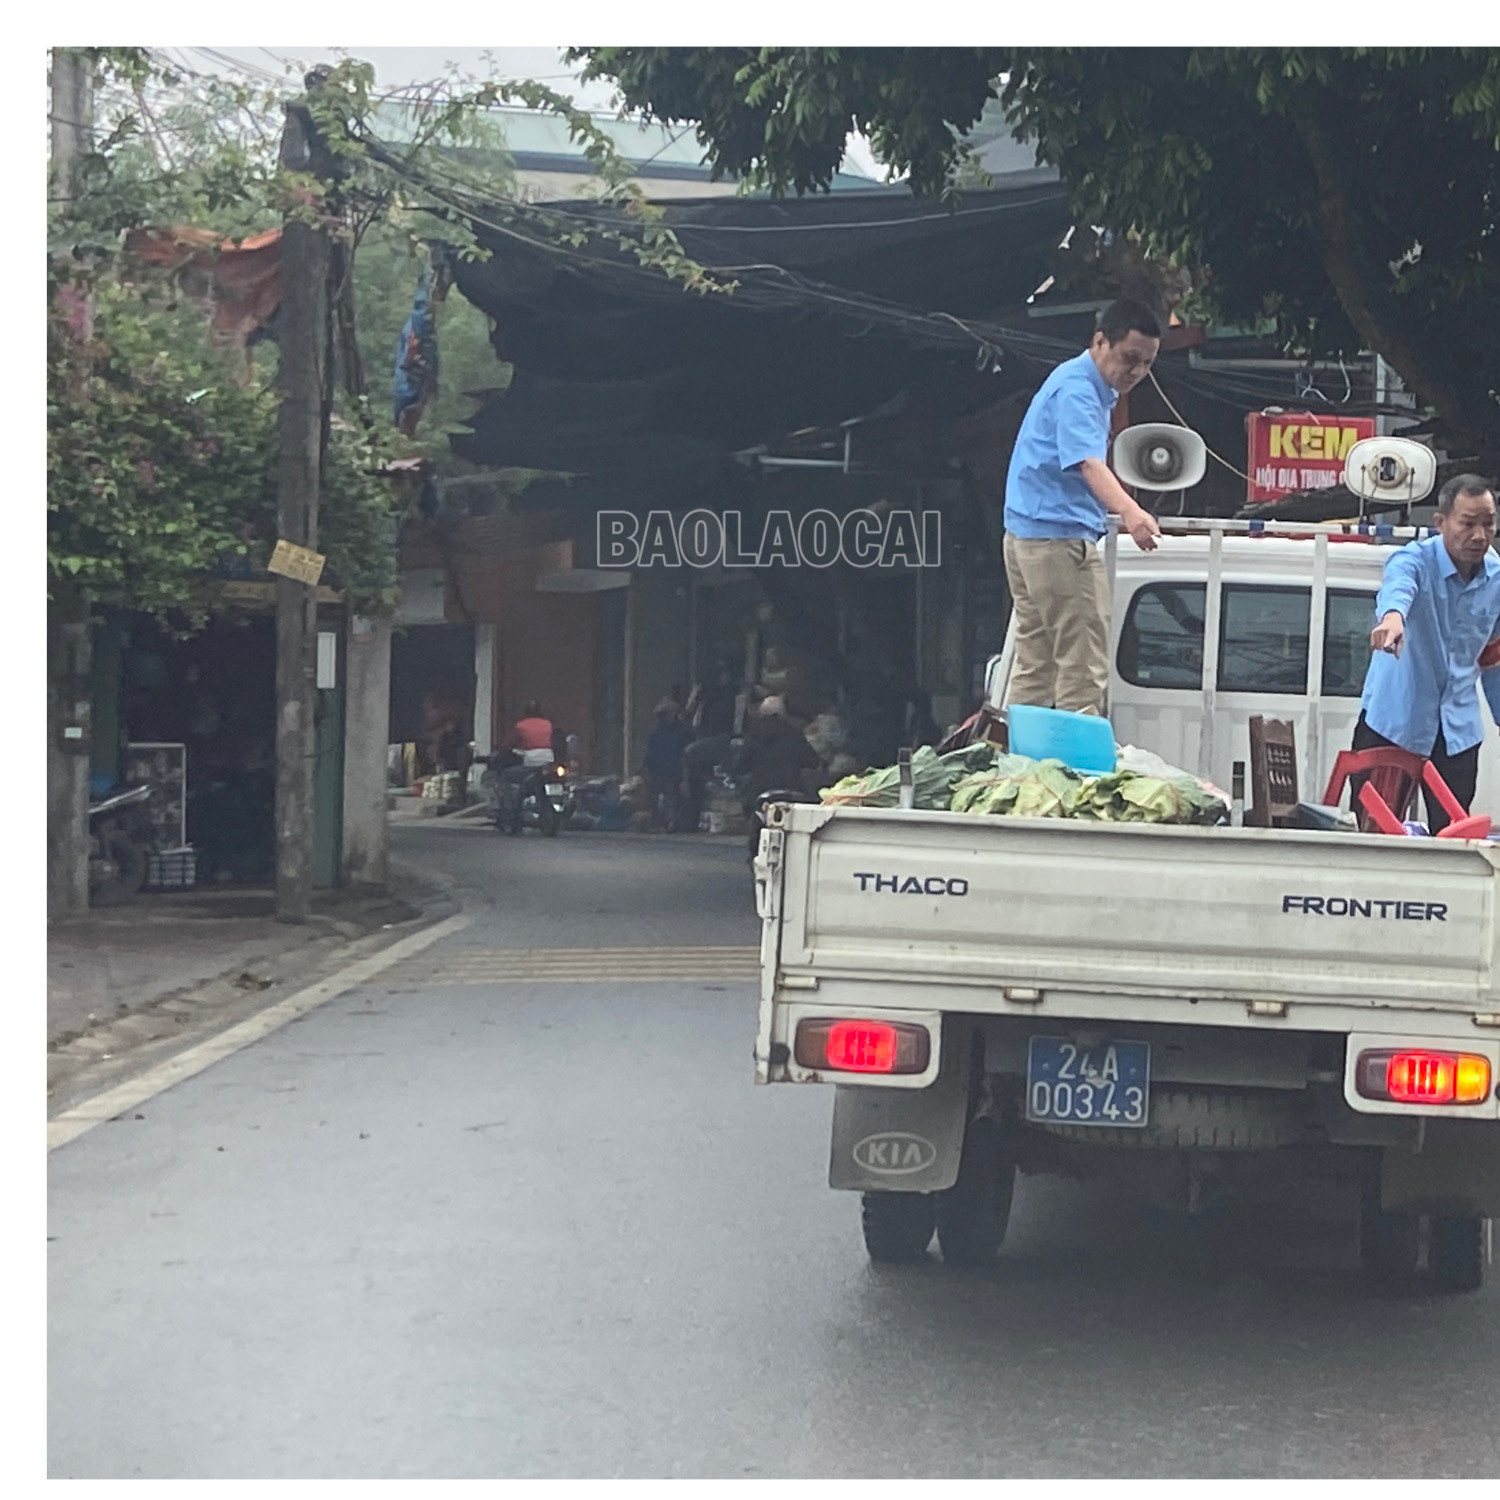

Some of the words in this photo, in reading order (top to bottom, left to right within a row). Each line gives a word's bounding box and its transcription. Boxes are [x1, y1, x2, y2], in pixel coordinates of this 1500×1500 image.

[1270, 424, 1358, 461] KEM
[853, 872, 970, 897] THACO
[1281, 894, 1449, 922] FRONTIER
[1032, 1081, 1144, 1122] 003.43
[868, 1141, 922, 1166] KIA
